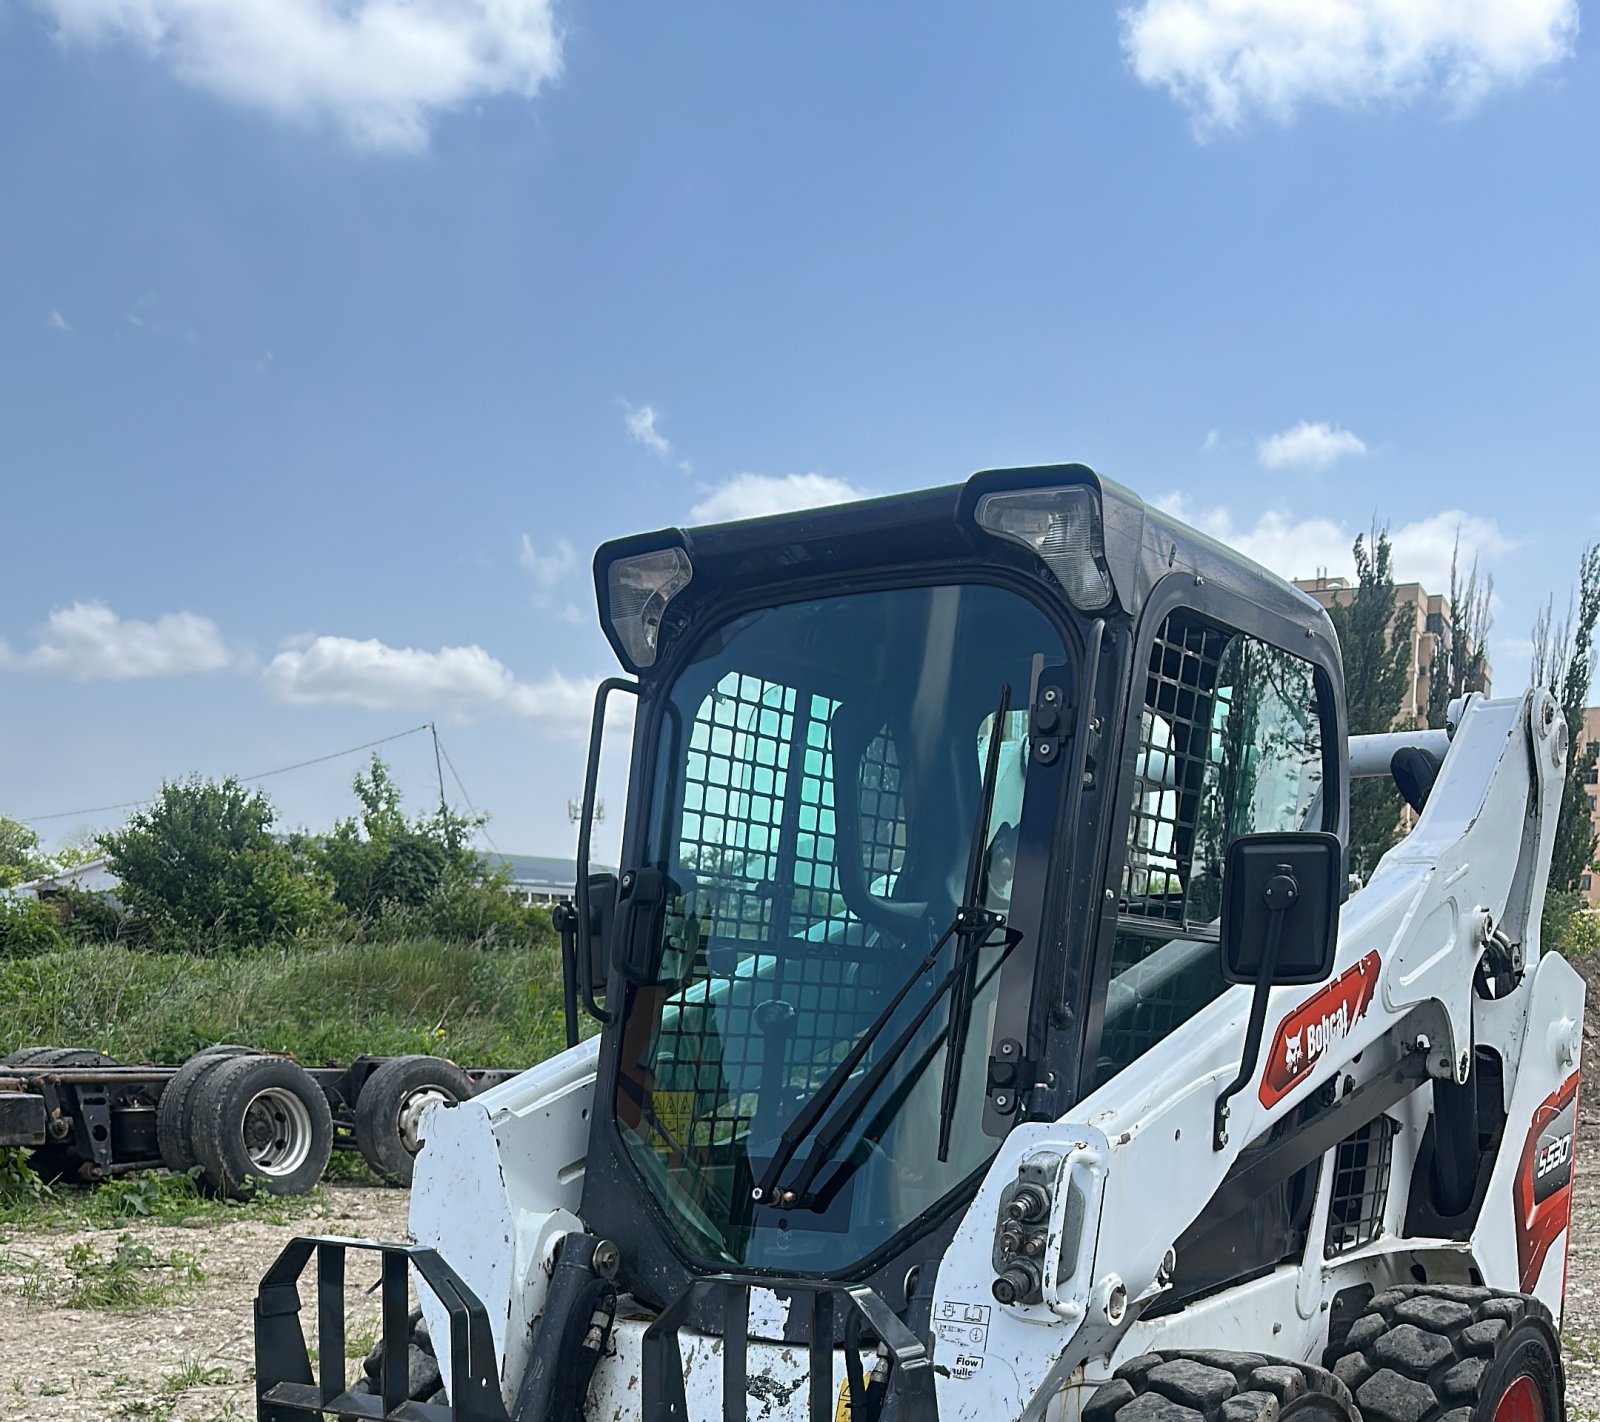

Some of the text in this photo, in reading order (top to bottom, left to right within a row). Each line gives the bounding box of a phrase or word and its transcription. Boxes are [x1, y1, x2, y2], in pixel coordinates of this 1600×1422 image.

[1307, 999, 1348, 1060] Bobcat
[1538, 1134, 1571, 1178] S530
[956, 1357, 979, 1367] Flow
